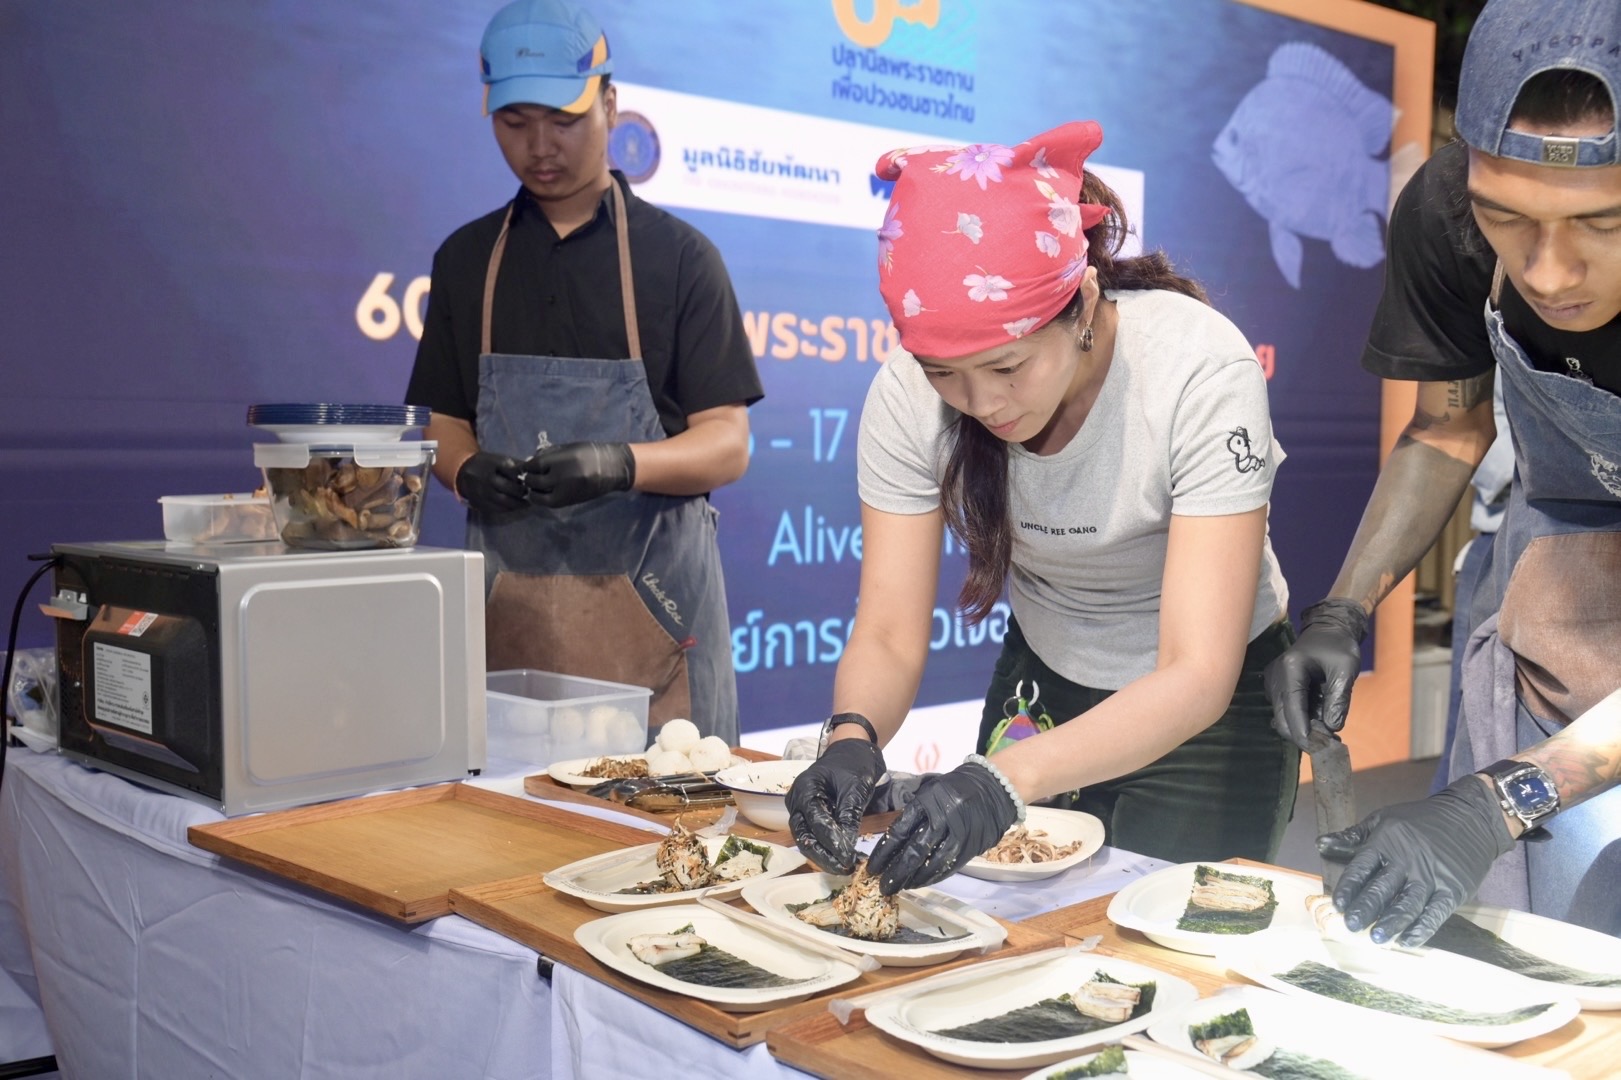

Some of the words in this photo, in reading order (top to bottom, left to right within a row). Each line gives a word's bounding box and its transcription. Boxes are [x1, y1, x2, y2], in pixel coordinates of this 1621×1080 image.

[683, 147, 841, 184] มูลนิธิชัยพัฒนา
[809, 408, 849, 462] 17
[1020, 521, 1048, 534] UNCLE
